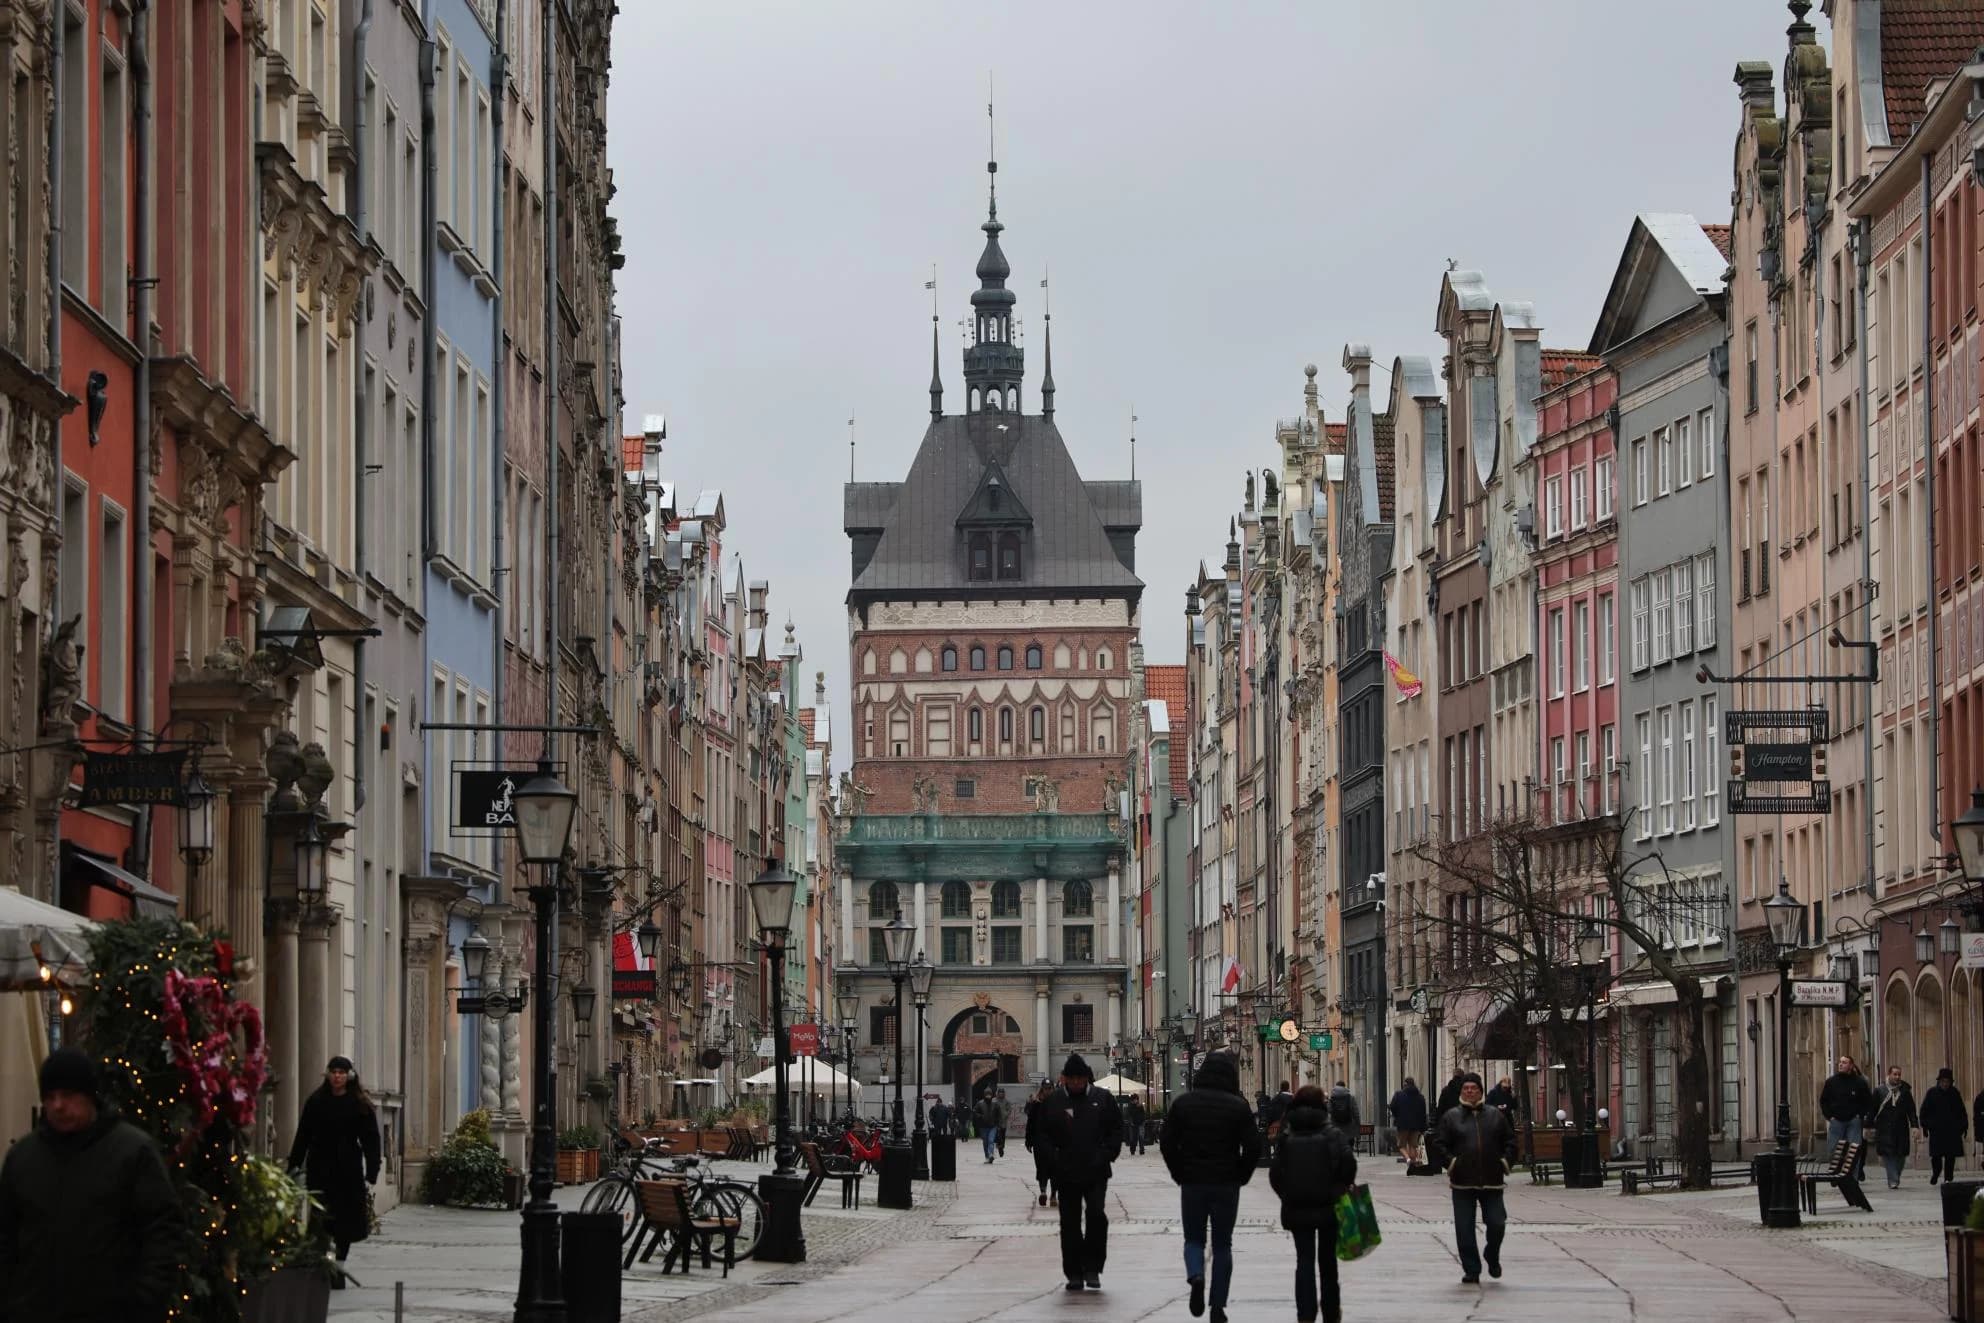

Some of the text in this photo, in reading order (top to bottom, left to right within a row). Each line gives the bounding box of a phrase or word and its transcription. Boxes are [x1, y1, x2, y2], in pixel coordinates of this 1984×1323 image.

[1752, 752, 1807, 768] Hampton
[90, 786, 173, 801] AMBER
[485, 812, 519, 824] BA
[612, 980, 655, 992] XCHANGE
